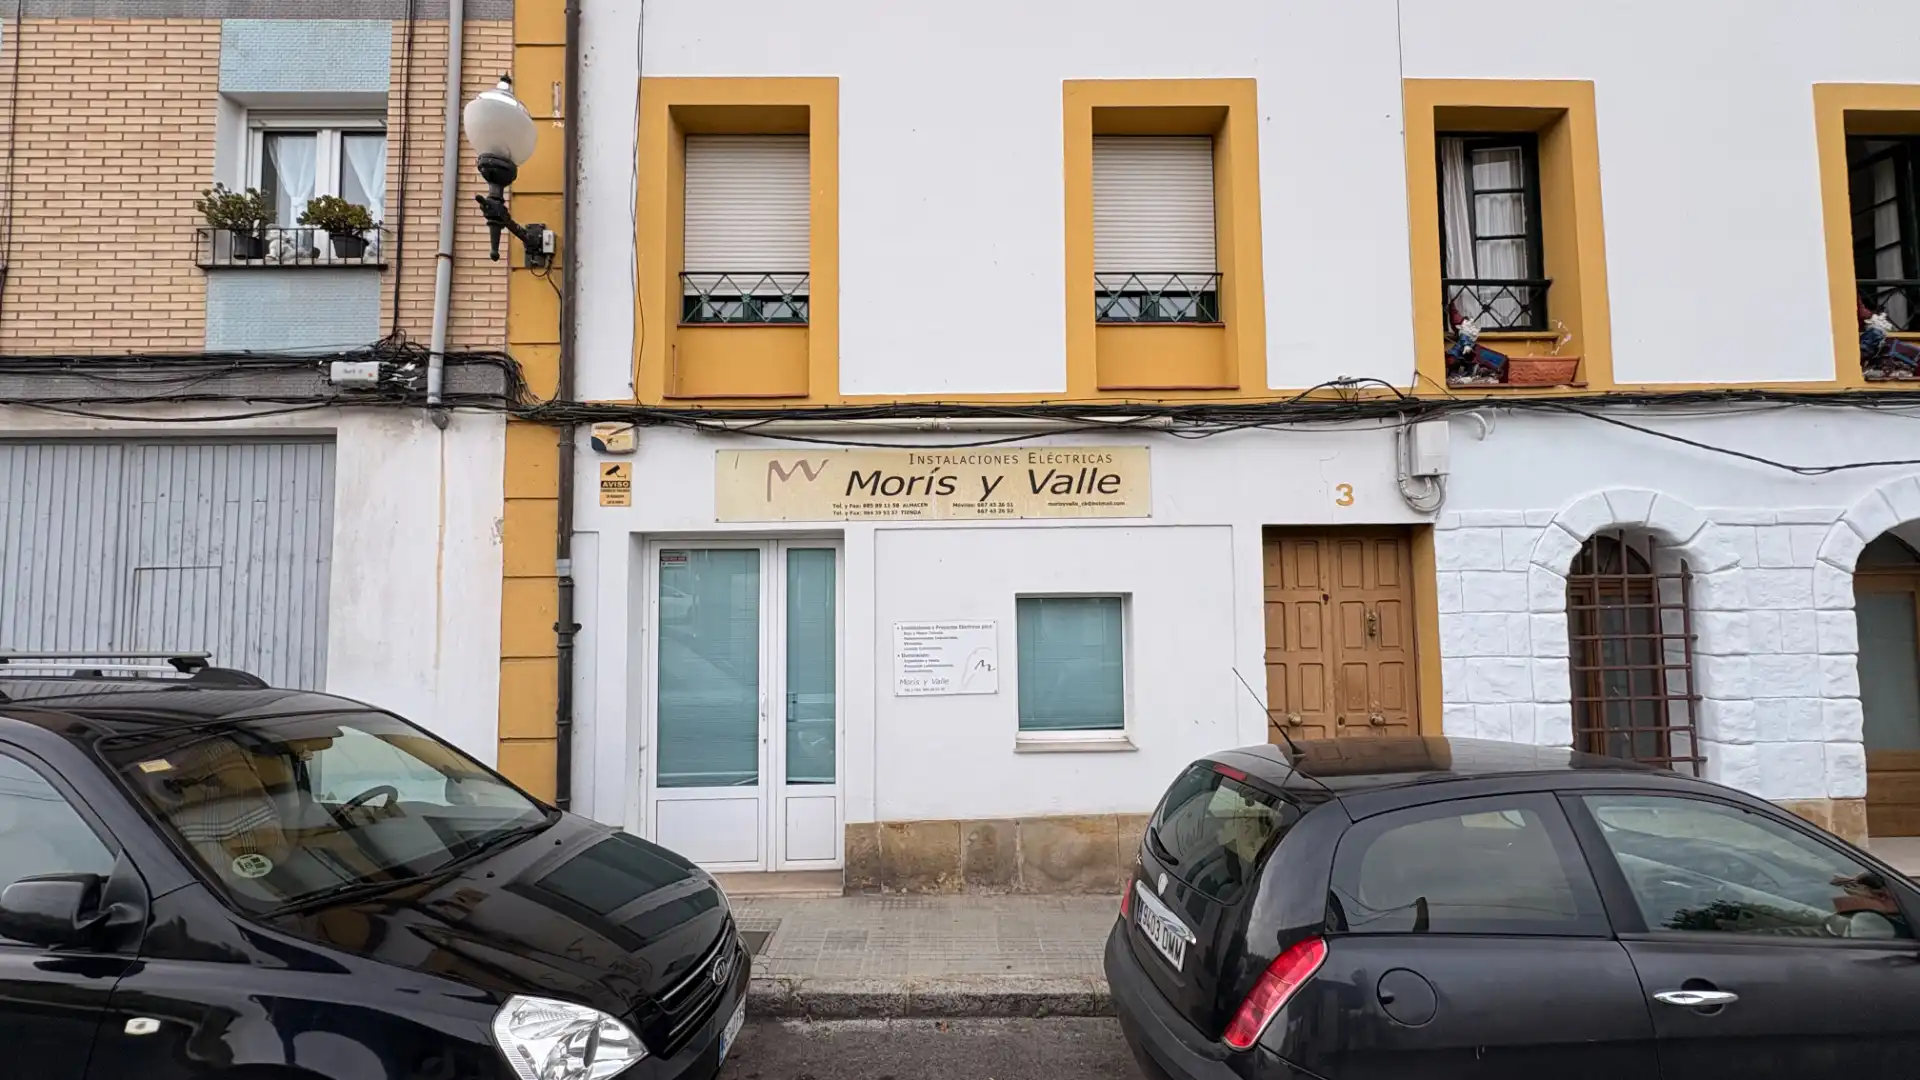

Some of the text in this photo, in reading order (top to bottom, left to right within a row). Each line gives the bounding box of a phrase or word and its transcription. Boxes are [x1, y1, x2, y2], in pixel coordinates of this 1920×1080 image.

[909, 452, 1112, 465] INSTALACIONES ELÉCTRICAS
[845, 466, 1121, 502] Morís y Valle
[1335, 483, 1354, 507] 3
[931, 677, 950, 685] Valle
